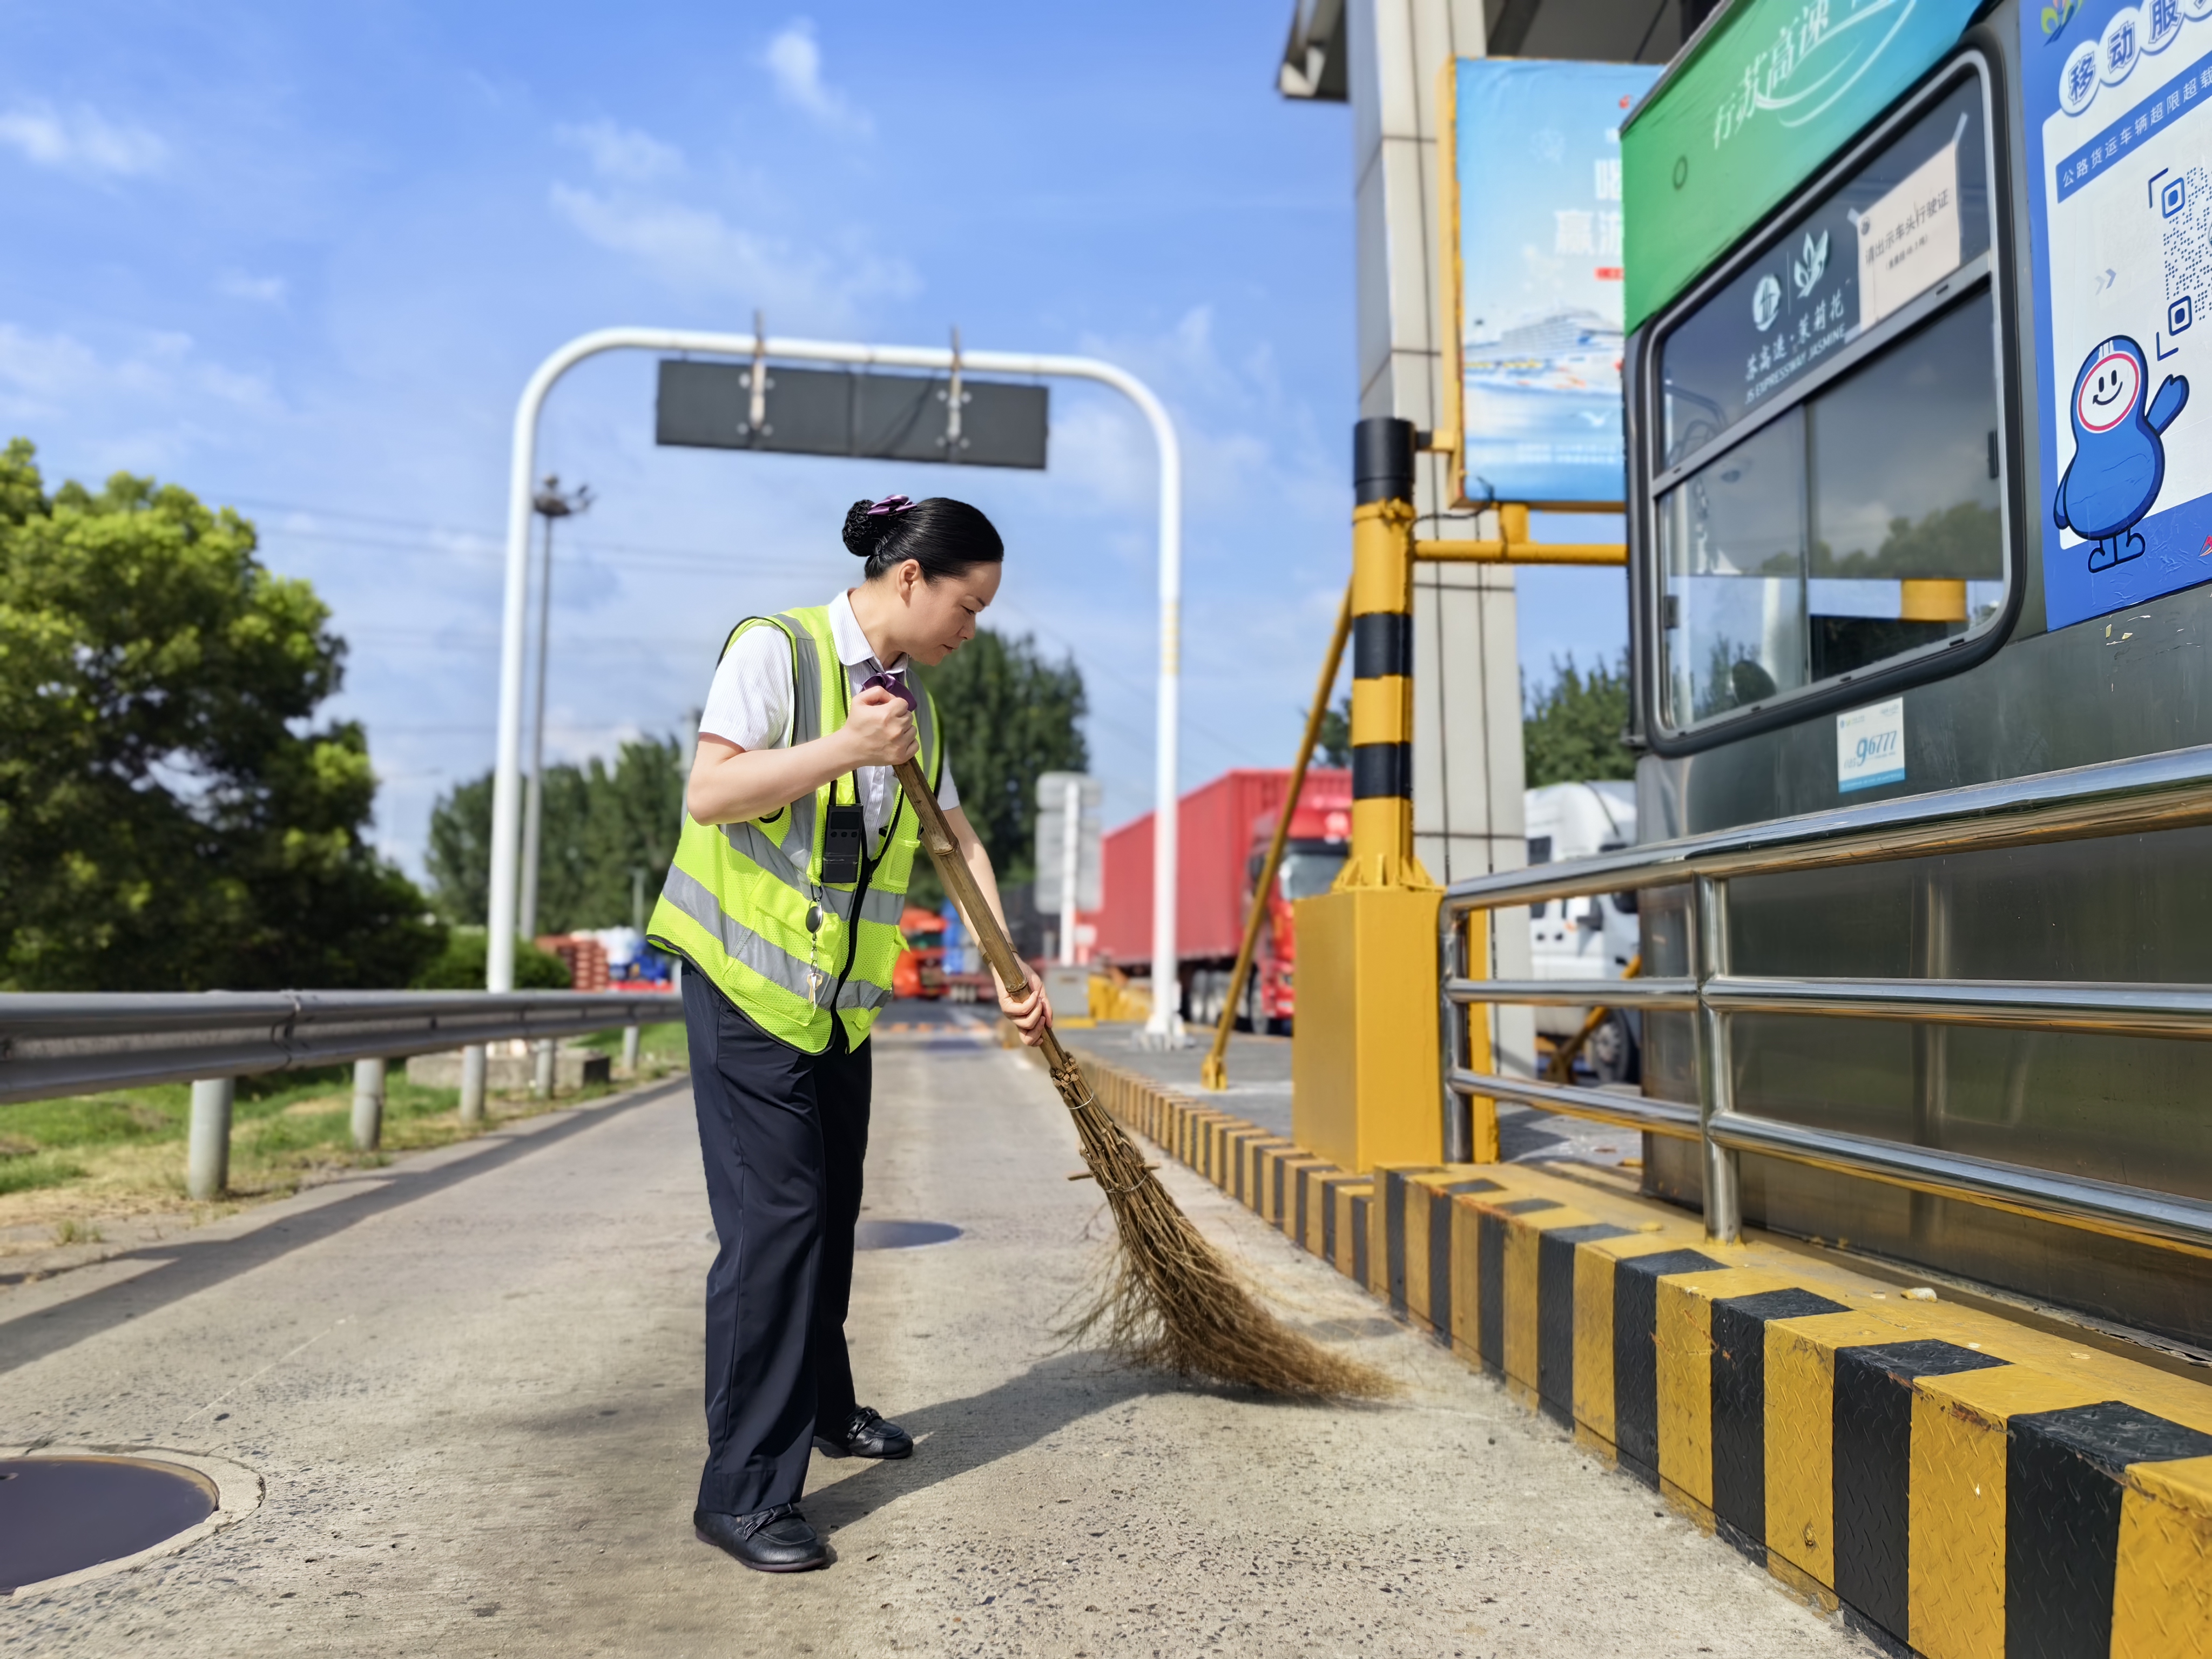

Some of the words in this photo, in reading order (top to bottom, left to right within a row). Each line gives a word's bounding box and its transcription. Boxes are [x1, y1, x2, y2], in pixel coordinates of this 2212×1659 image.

[2068, 0, 2212, 105] 移动服
[2062, 66, 2212, 188] 公路货运车辆超限超载
[1865, 188, 1948, 265] 请出示车头行驶证
[1745, 388, 1755, 404] JS
[1755, 350, 1806, 397] EXPRESSWAY
[1808, 323, 1846, 361] JASMINE
[1856, 731, 1897, 767] 96777
